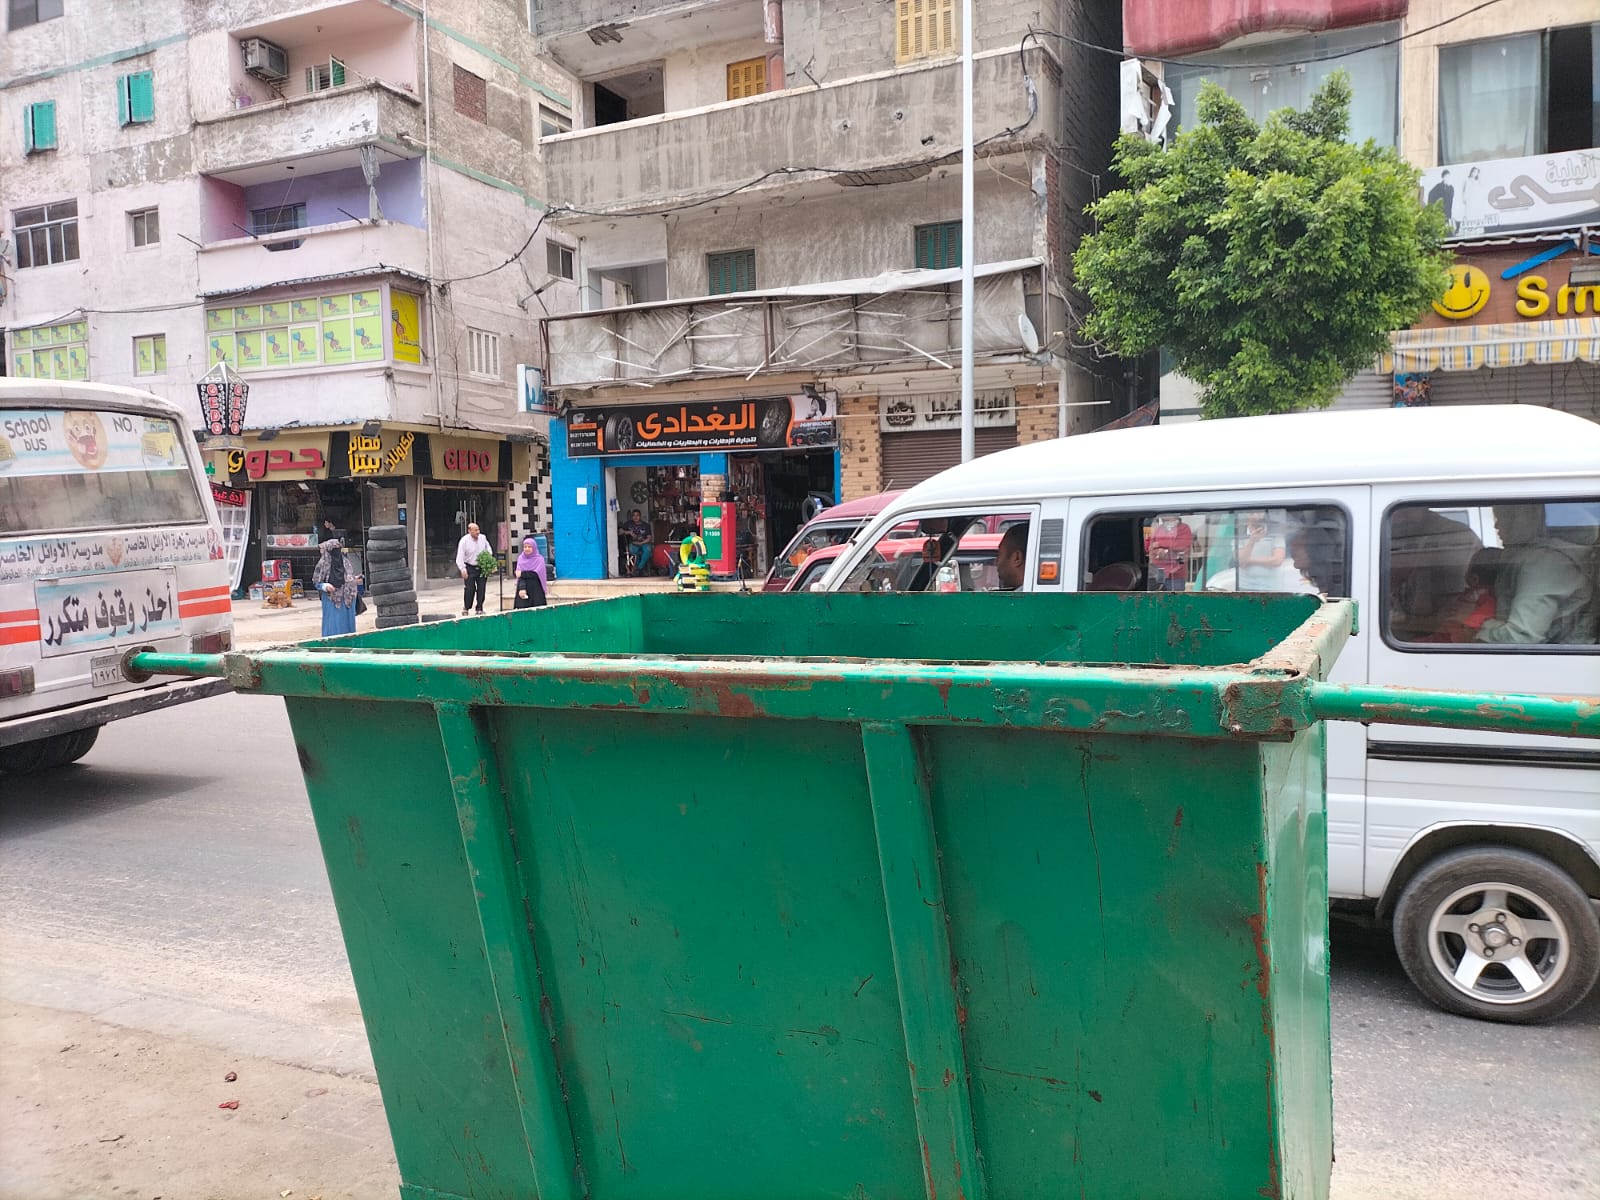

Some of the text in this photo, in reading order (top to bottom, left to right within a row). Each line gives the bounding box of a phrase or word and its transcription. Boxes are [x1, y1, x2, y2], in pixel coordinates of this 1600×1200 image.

[4, 412, 52, 439] School
[636, 403, 756, 440] البغدادى
[245, 447, 325, 479] جدو
[444, 448, 492, 471] GEDO
[72, 541, 104, 560] مدرسة
[44, 594, 89, 646] متكرر
[95, 588, 136, 637] وقوف
